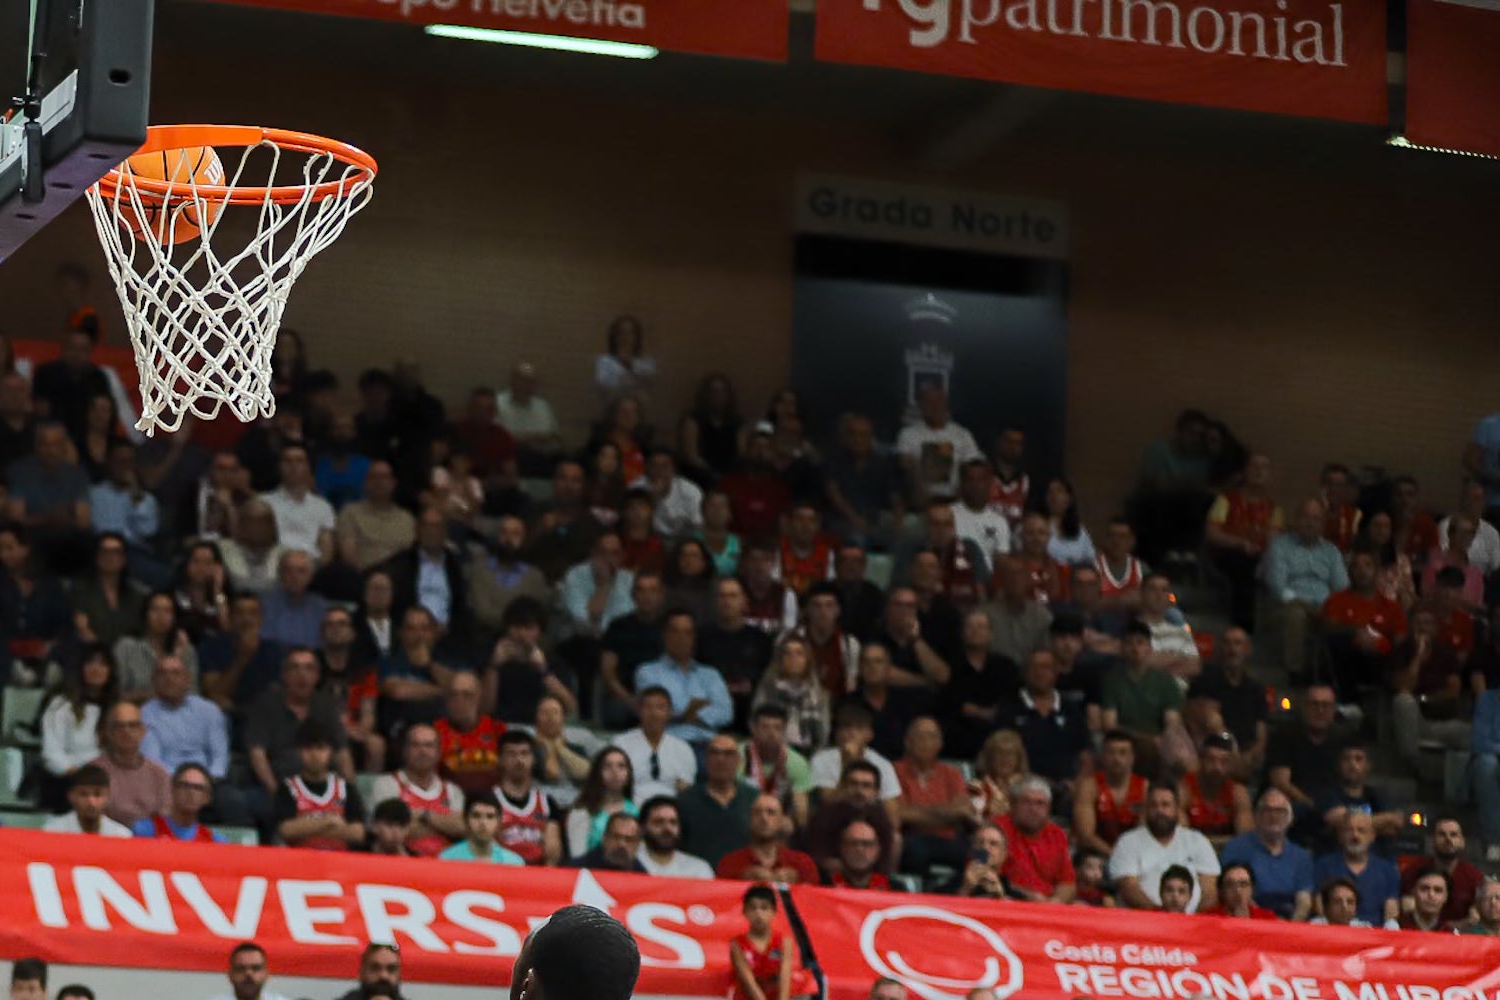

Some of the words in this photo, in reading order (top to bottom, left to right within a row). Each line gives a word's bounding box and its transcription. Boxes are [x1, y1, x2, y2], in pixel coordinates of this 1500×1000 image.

[807, 187, 932, 229] Grada
[951, 204, 1056, 242] Norte
[1044, 939, 1117, 963] Costa
